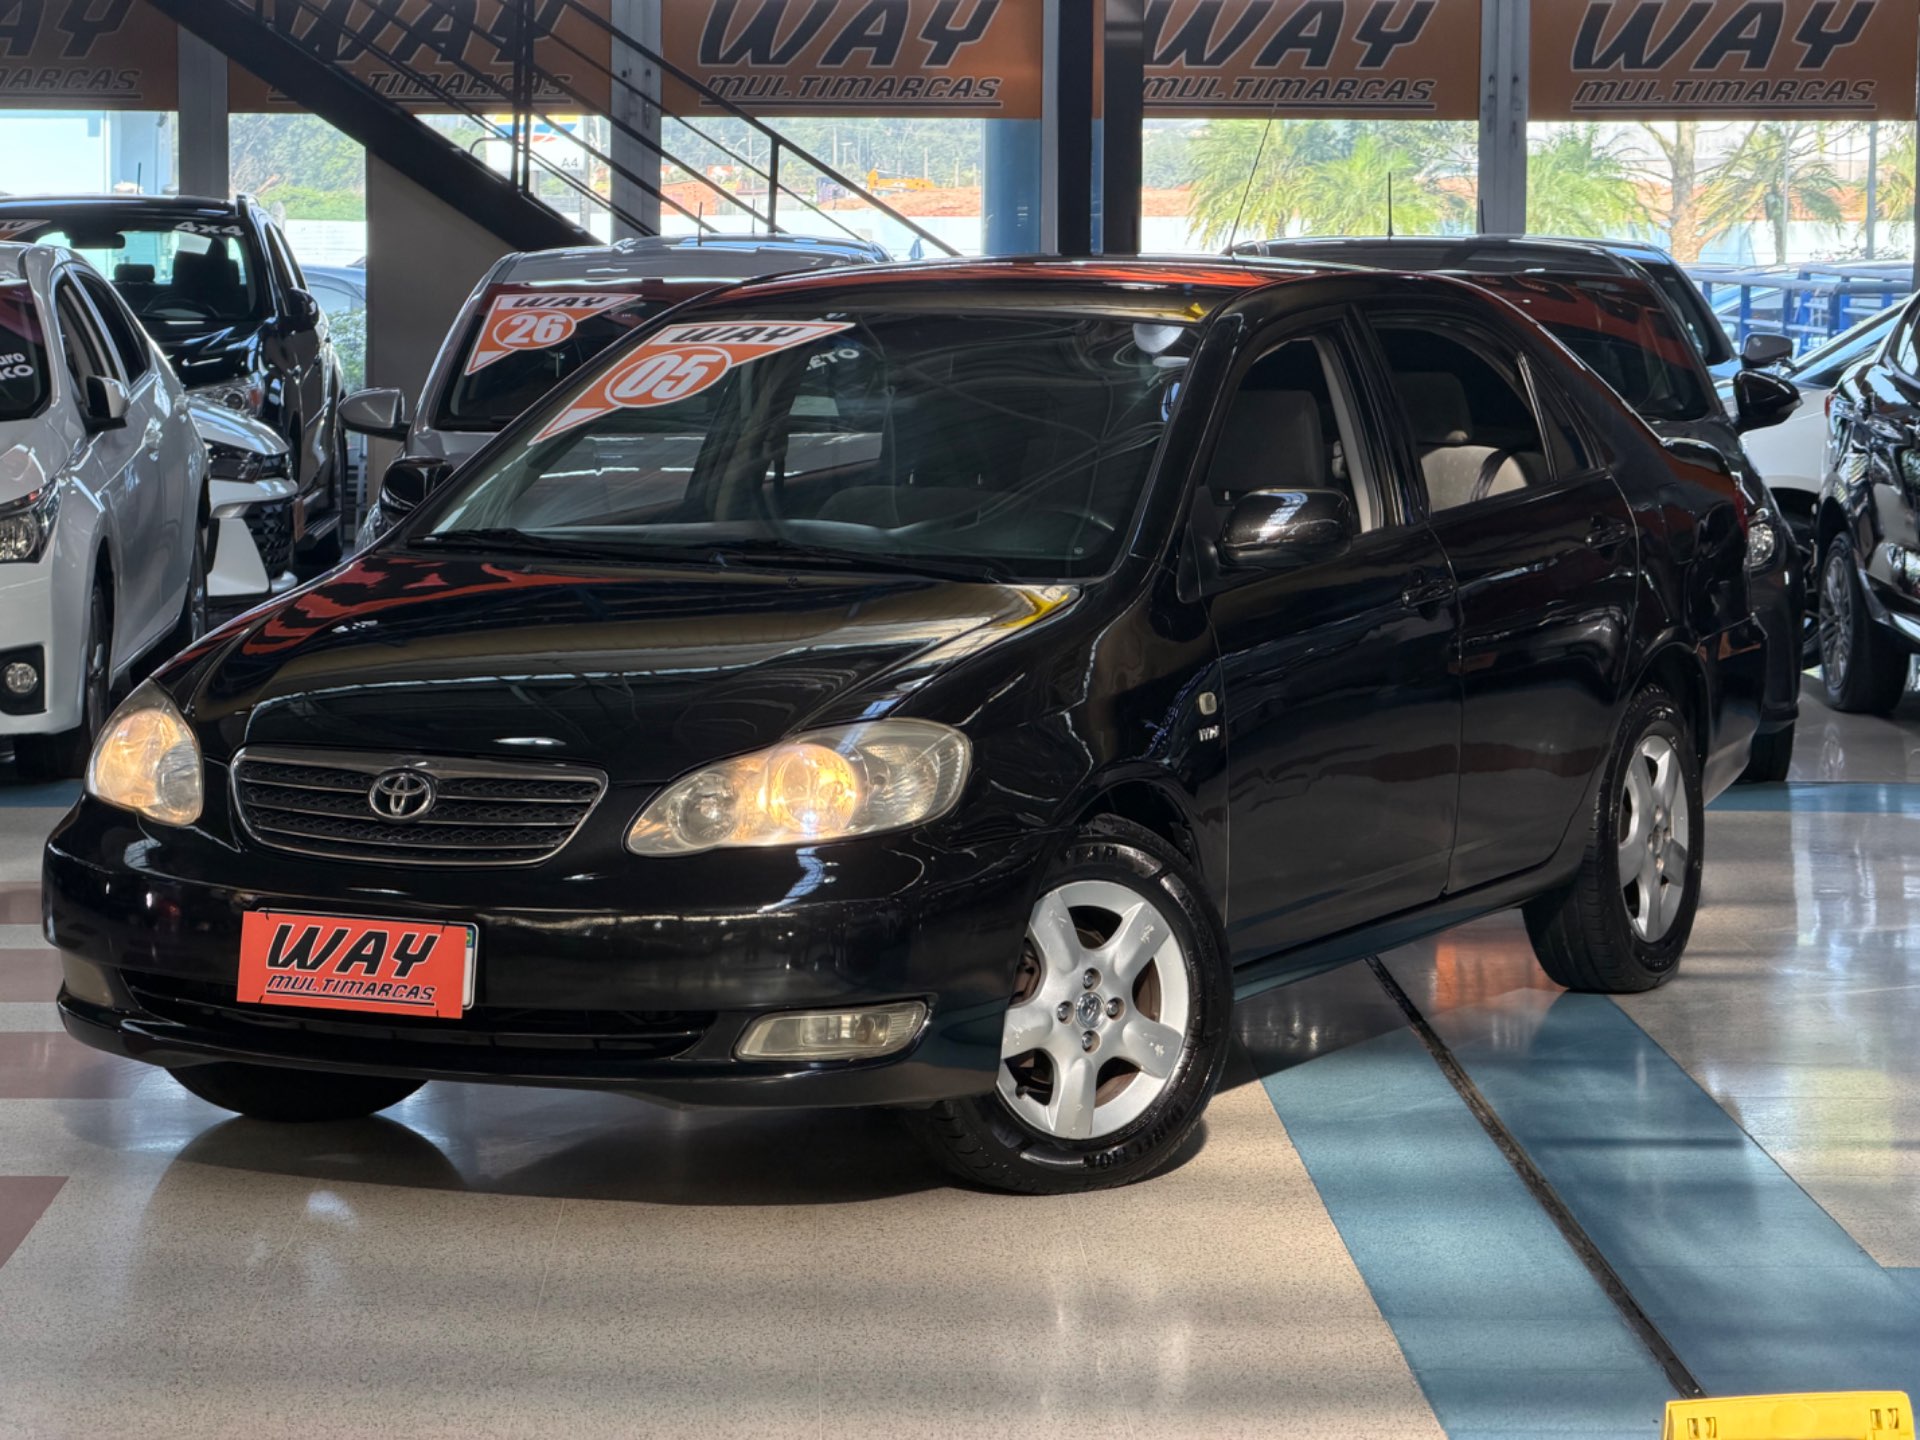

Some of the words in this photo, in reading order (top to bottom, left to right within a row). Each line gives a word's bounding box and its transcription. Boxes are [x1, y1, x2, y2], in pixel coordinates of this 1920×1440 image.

[698, 0, 1000, 68] WAY
[1143, 0, 1438, 69] WAY
[1570, 0, 1878, 71] WAY
[702, 75, 1003, 98] MULTIMARCAS
[1143, 75, 1437, 101] MULTIMARCAS
[1572, 79, 1878, 103] MULTIMARCAS
[561, 157, 579, 168] A4
[512, 297, 609, 308] WAY
[502, 314, 567, 344] 26
[670, 325, 805, 344] WAY
[612, 355, 720, 400] 05
[266, 922, 440, 979] WAY
[266, 973, 436, 1001] MULTIMARCAS
